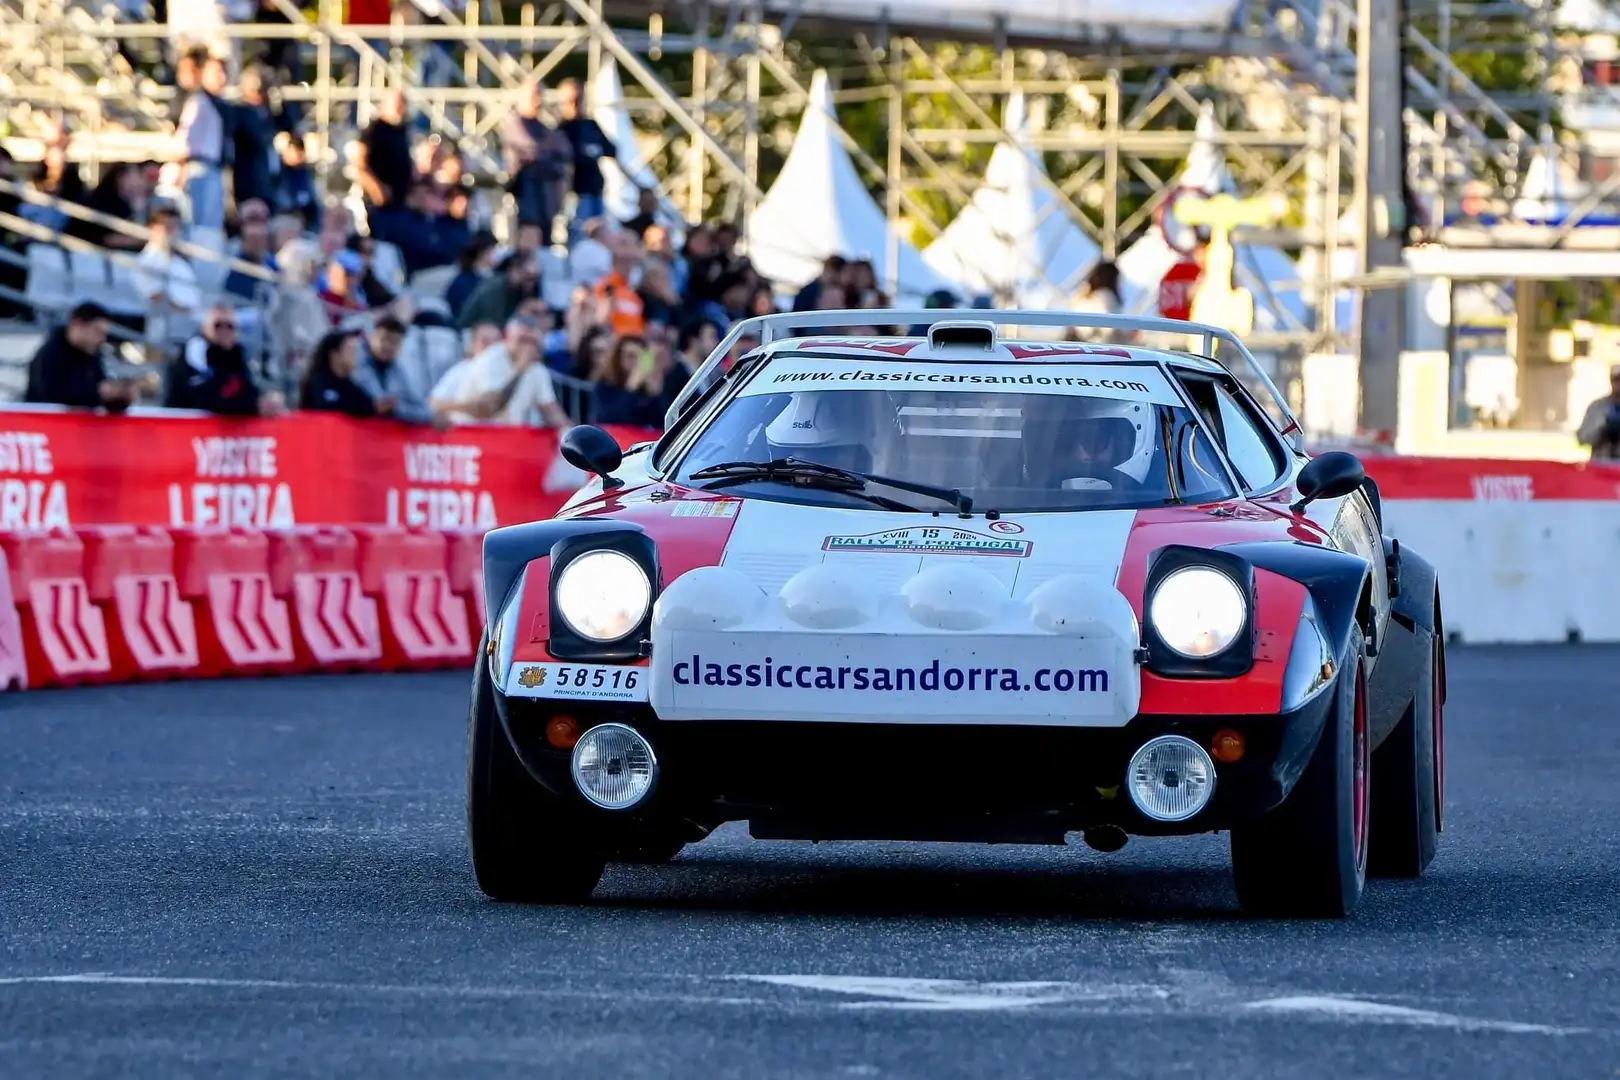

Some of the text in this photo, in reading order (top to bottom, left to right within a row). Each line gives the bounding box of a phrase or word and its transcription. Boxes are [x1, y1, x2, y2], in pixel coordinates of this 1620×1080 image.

[773, 370, 1150, 393] www.classiccarsandorra.com
[192, 436, 278, 478] VISITE
[403, 443, 482, 485] VISITE
[168, 482, 295, 530] LEIRIA
[386, 488, 498, 530] LEIRIA
[831, 537, 889, 545] RALLY
[924, 539, 1025, 549] PORTUGAL
[882, 528, 977, 541] XVIII 15 2024
[556, 667, 639, 689] 58516
[672, 654, 1109, 692] classiccarsandorra.com
[553, 689, 634, 698] PRINCIPAT D'ANDORRA
